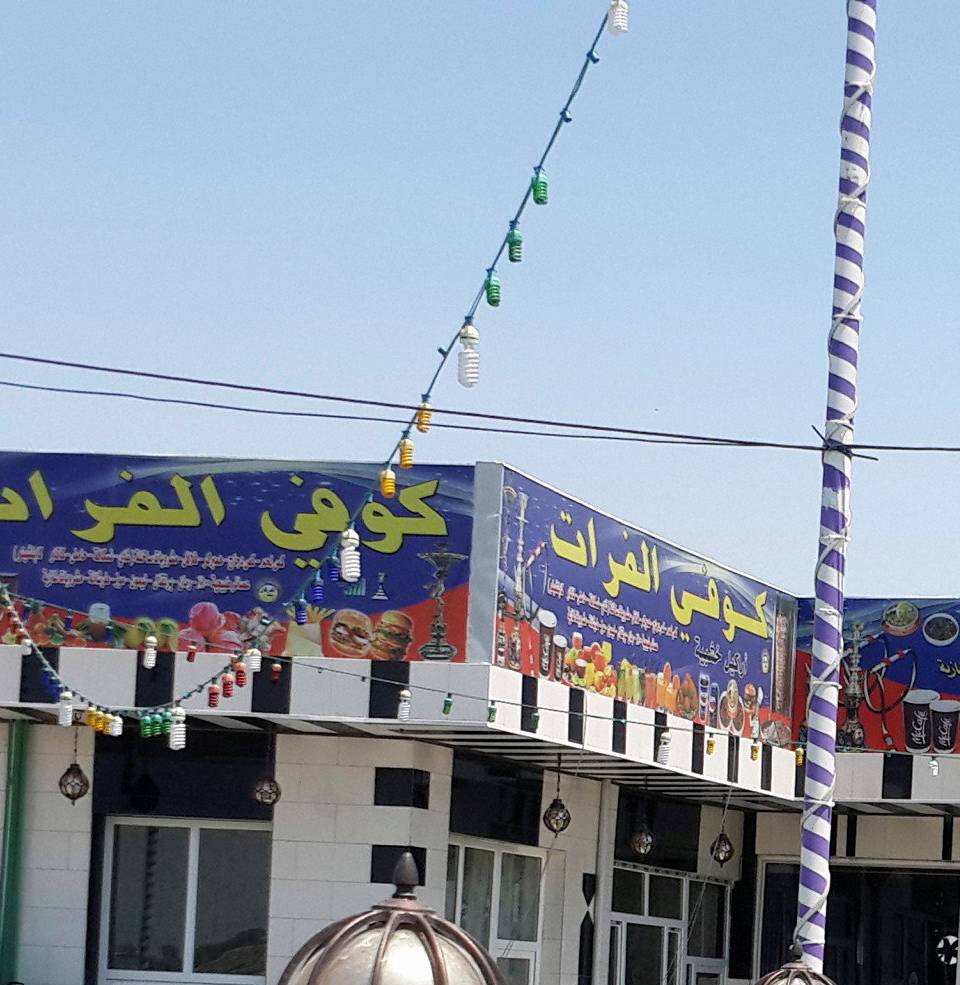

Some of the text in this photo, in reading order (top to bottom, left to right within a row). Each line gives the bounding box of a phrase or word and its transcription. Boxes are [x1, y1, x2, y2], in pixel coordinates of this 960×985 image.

[260, 474, 449, 569] كوفي
[550, 510, 660, 598] الفرات
[669, 562, 769, 643] كوفي
